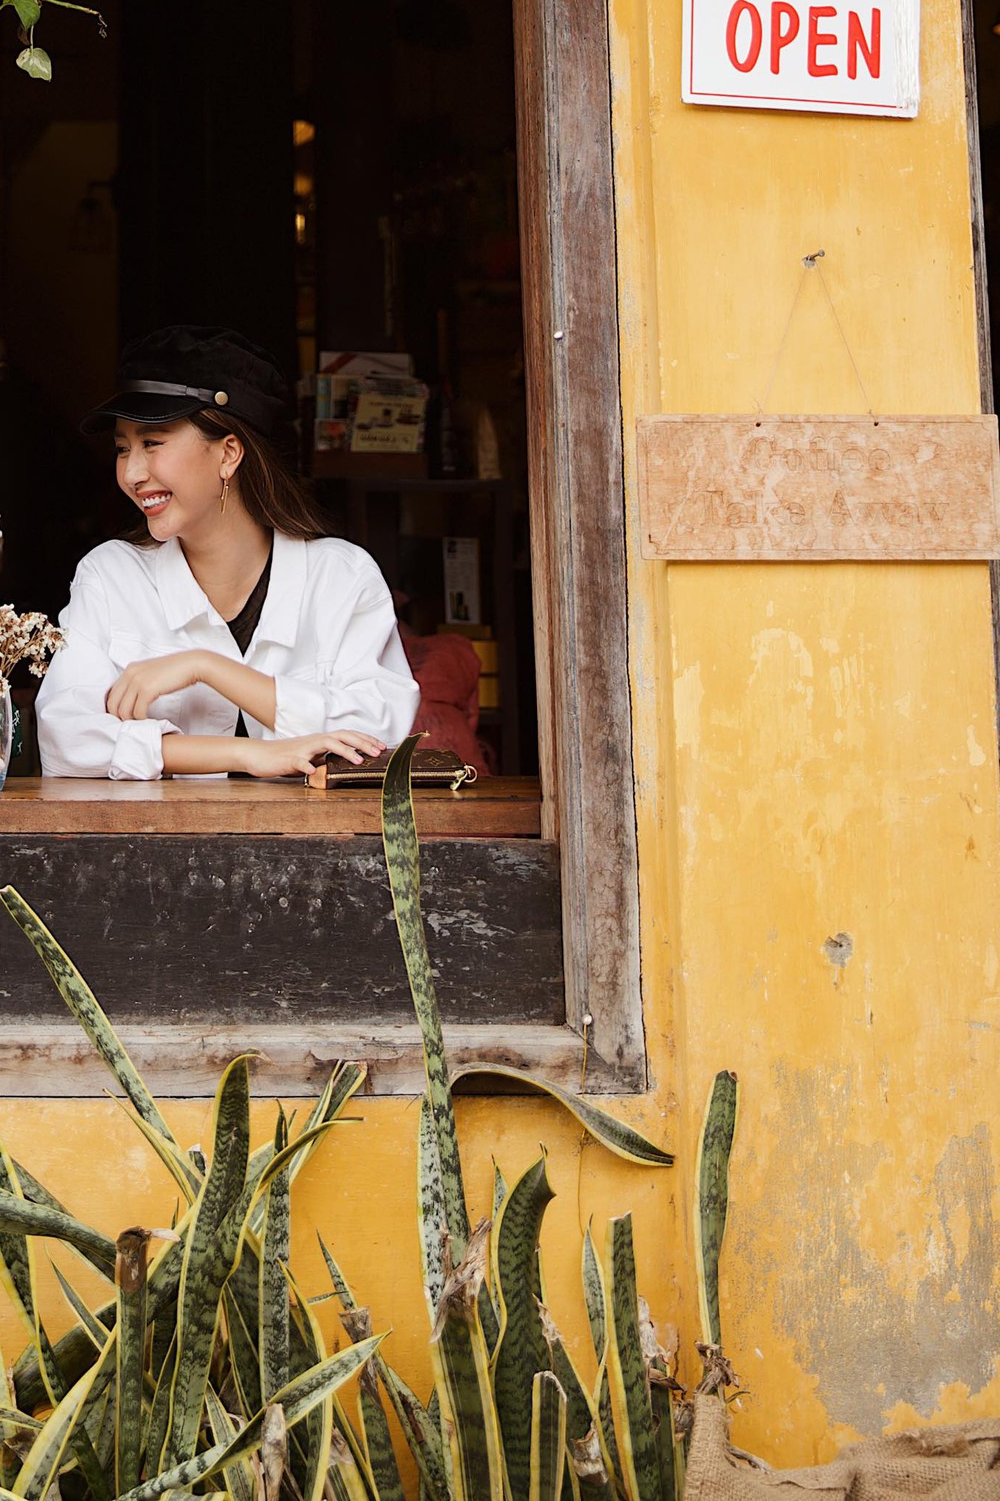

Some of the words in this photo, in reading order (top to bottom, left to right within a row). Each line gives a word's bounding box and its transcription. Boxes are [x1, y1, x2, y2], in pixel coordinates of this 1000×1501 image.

[748, 434, 892, 473] Coffee
[691, 489, 806, 526] Take
[827, 489, 951, 536] Away
